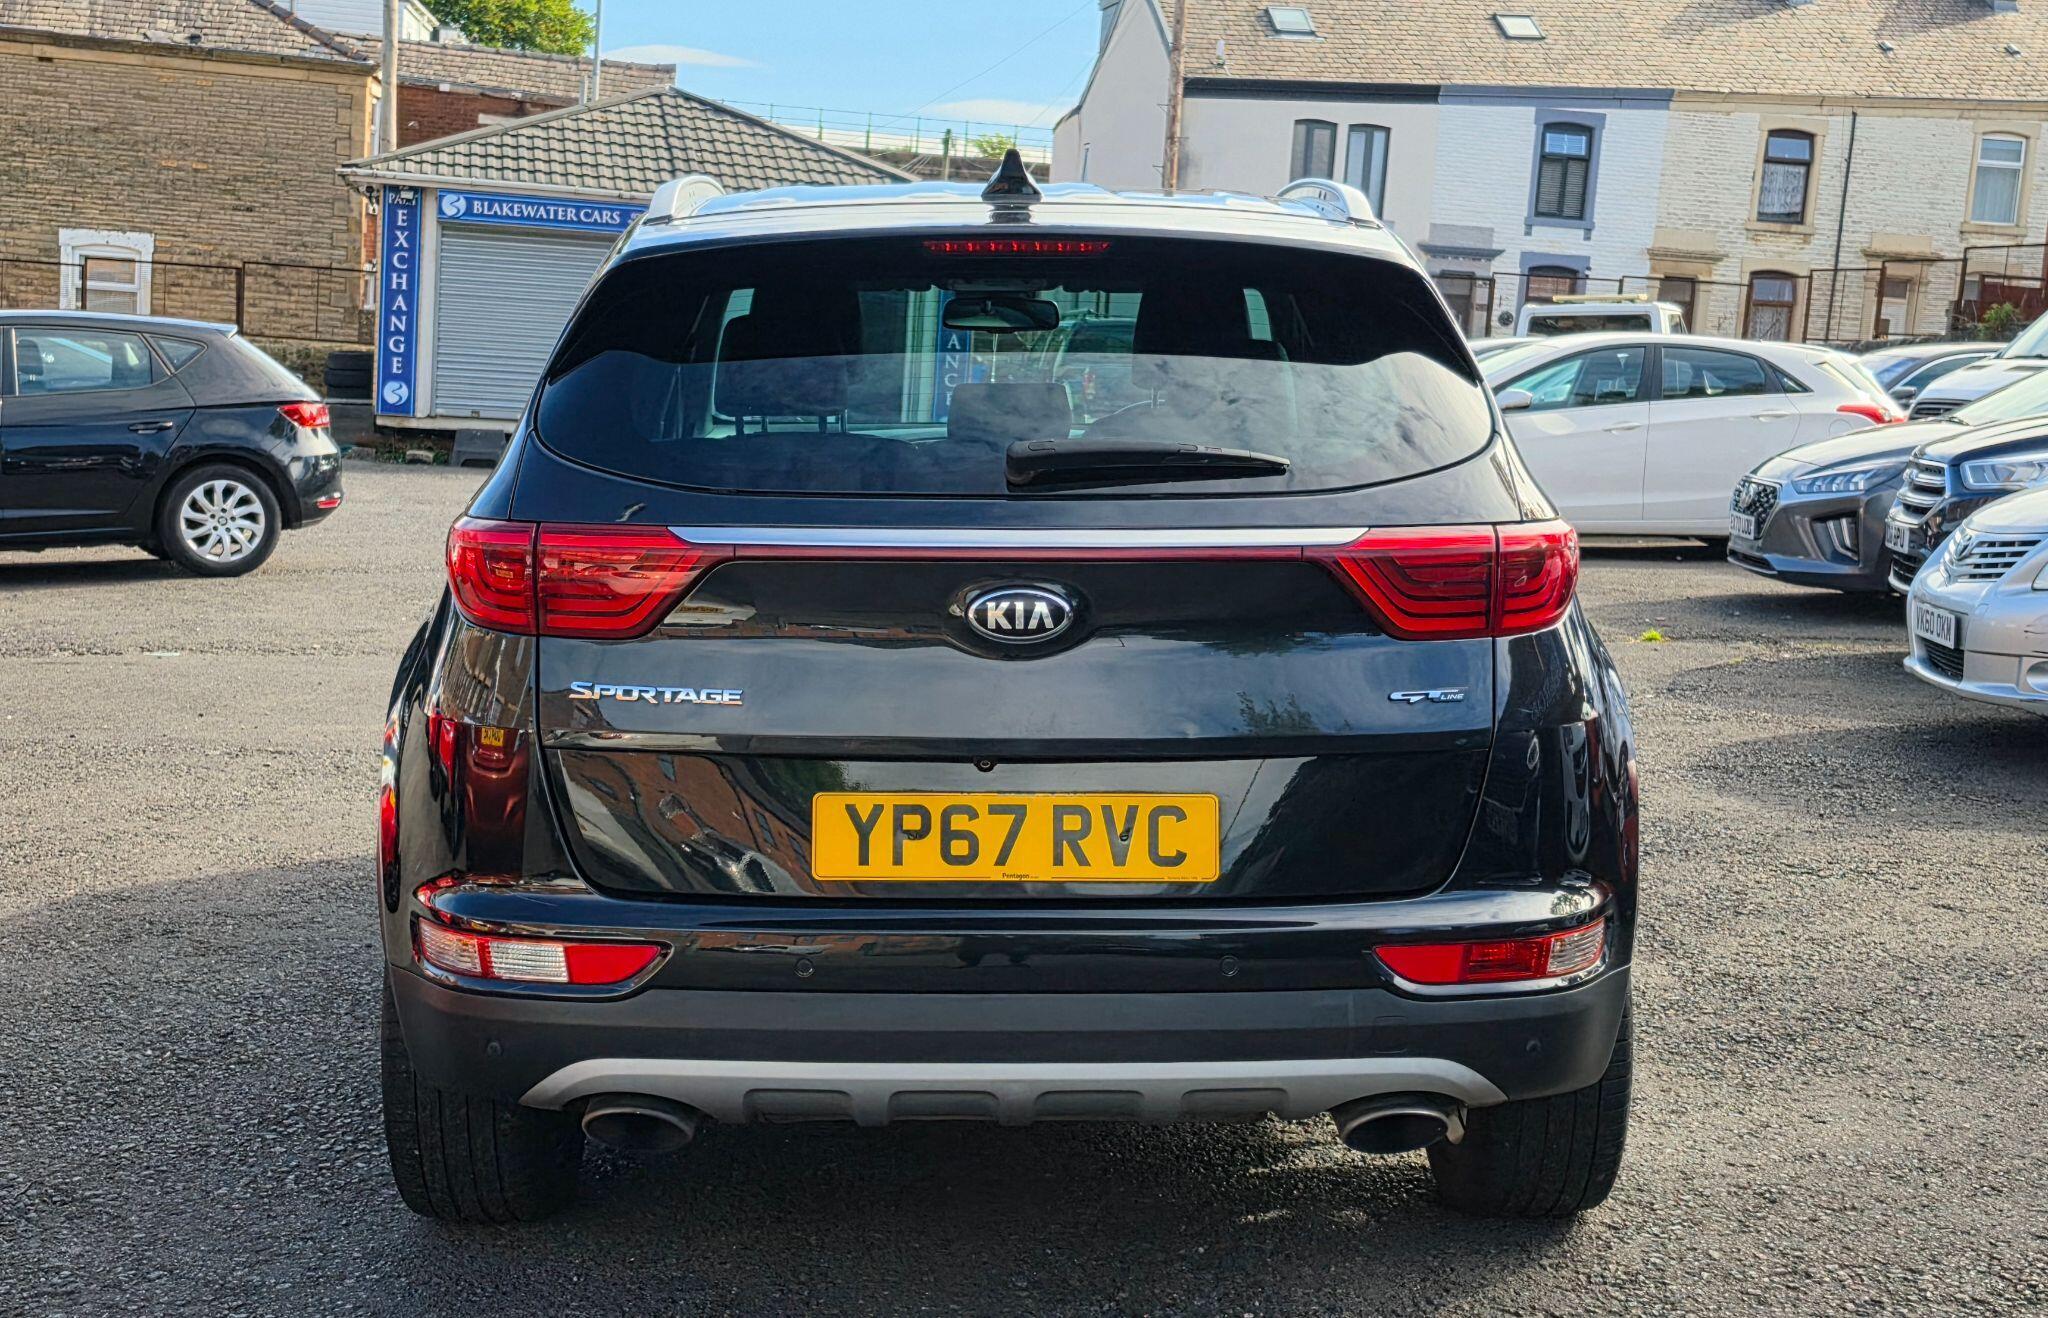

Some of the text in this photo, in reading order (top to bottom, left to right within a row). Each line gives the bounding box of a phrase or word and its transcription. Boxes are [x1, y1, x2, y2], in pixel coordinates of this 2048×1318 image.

[473, 200, 577, 221] BLAKEWATER
[579, 208, 621, 225] CARS
[388, 209, 409, 374] EXCHANGE
[986, 601, 1055, 630] KIA
[1916, 605, 1934, 635] VK60
[568, 681, 743, 705] SPORTAGE
[844, 803, 1188, 868] YP67 RVC
[1002, 872, 1030, 880] Pentagon
